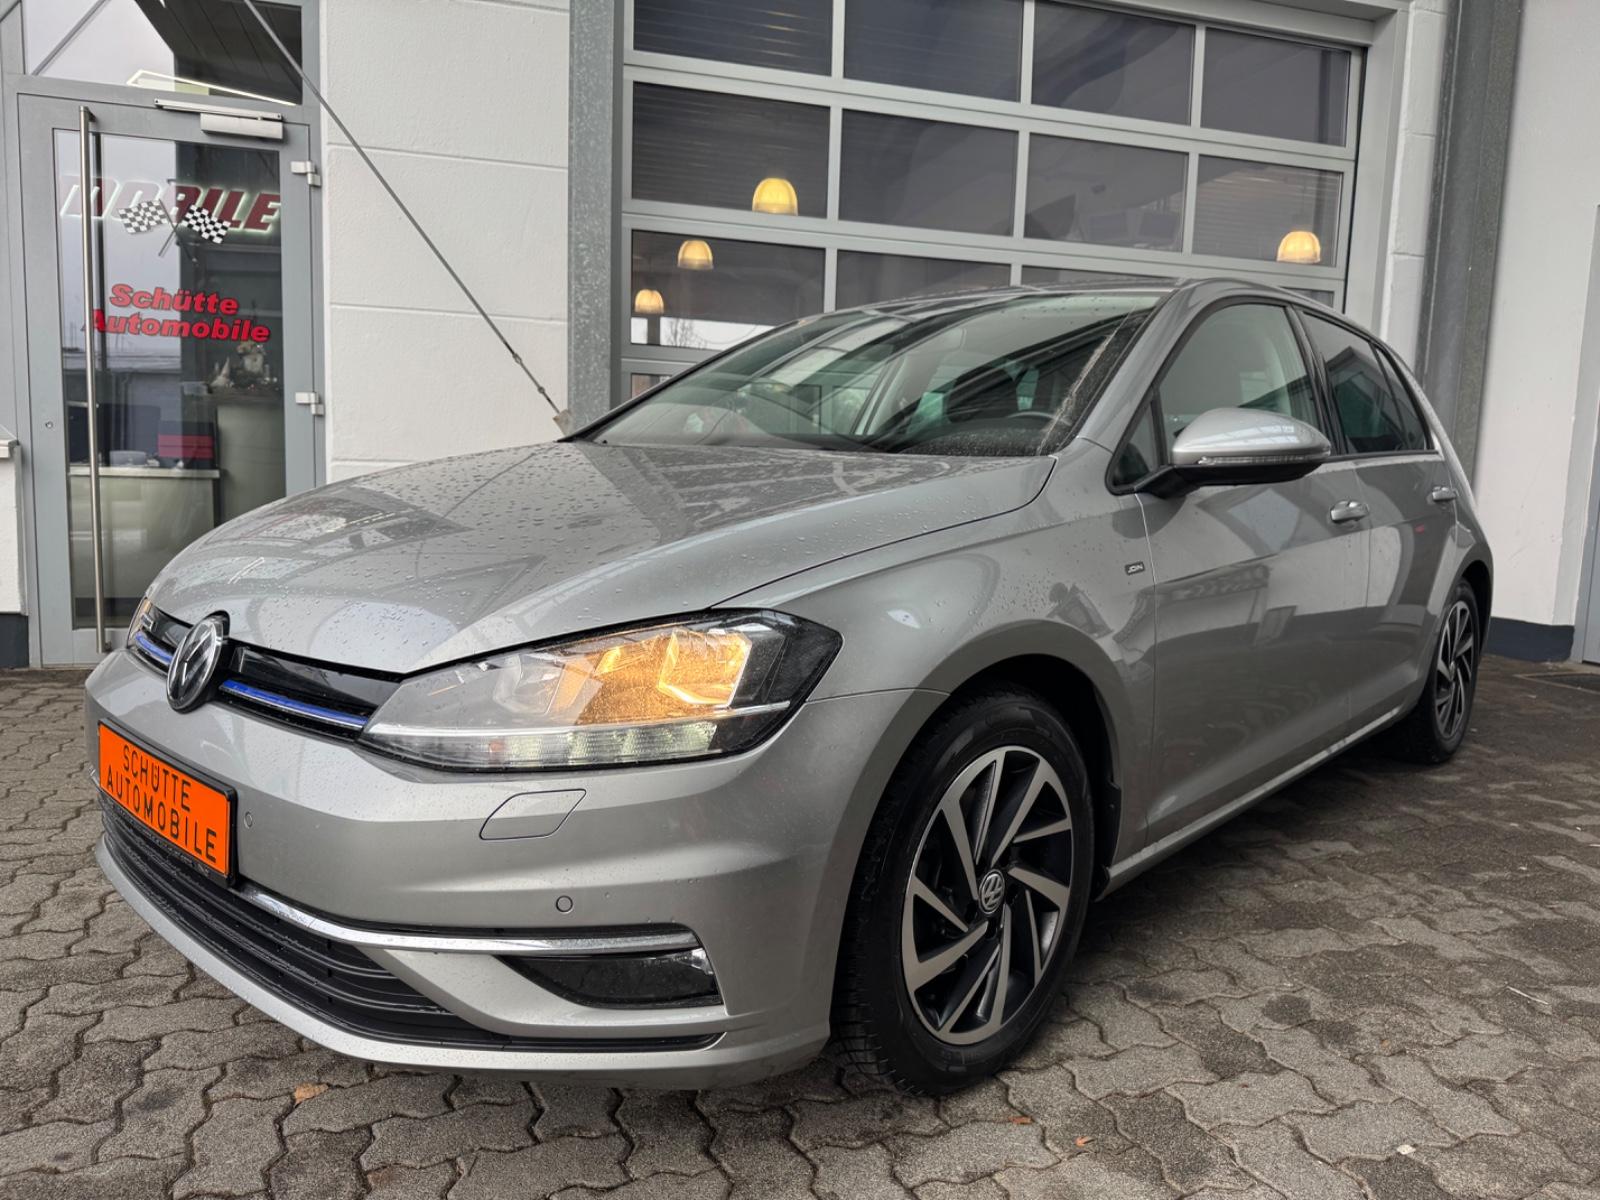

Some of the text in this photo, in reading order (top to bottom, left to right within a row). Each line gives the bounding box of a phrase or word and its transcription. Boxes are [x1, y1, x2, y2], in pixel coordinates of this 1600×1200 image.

[109, 284, 238, 314] Schütte
[83, 309, 270, 342] Automobile
[123, 744, 191, 813] SCHÜTTE
[106, 764, 217, 863] AUTOMOBILE
